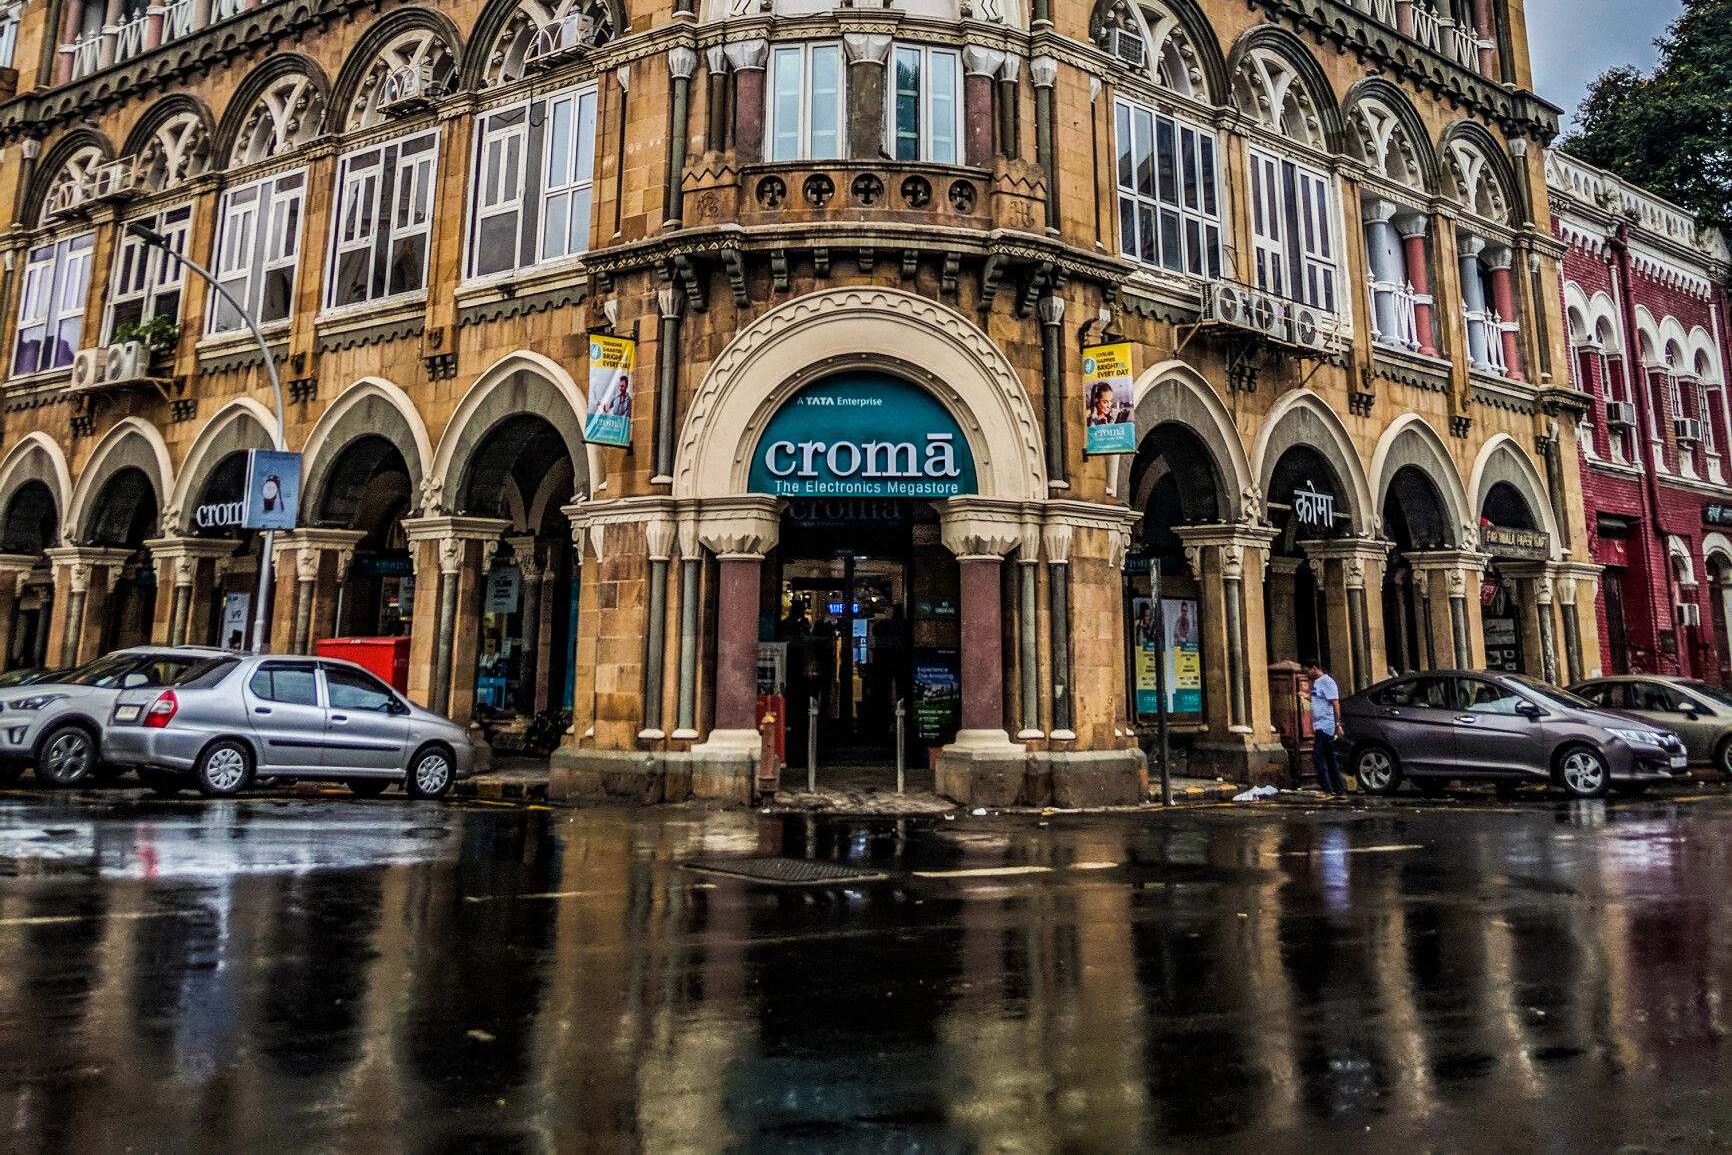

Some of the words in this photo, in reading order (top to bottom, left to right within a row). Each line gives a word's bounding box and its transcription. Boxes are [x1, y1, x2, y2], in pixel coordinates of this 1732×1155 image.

[797, 397, 804, 405] A
[806, 397, 834, 406] TATA
[837, 397, 882, 407] Enterprise
[765, 433, 961, 478] cromā
[775, 480, 799, 493] The
[806, 480, 881, 494] Electronics
[887, 480, 958, 495] Megastore
[196, 501, 245, 528] crom
